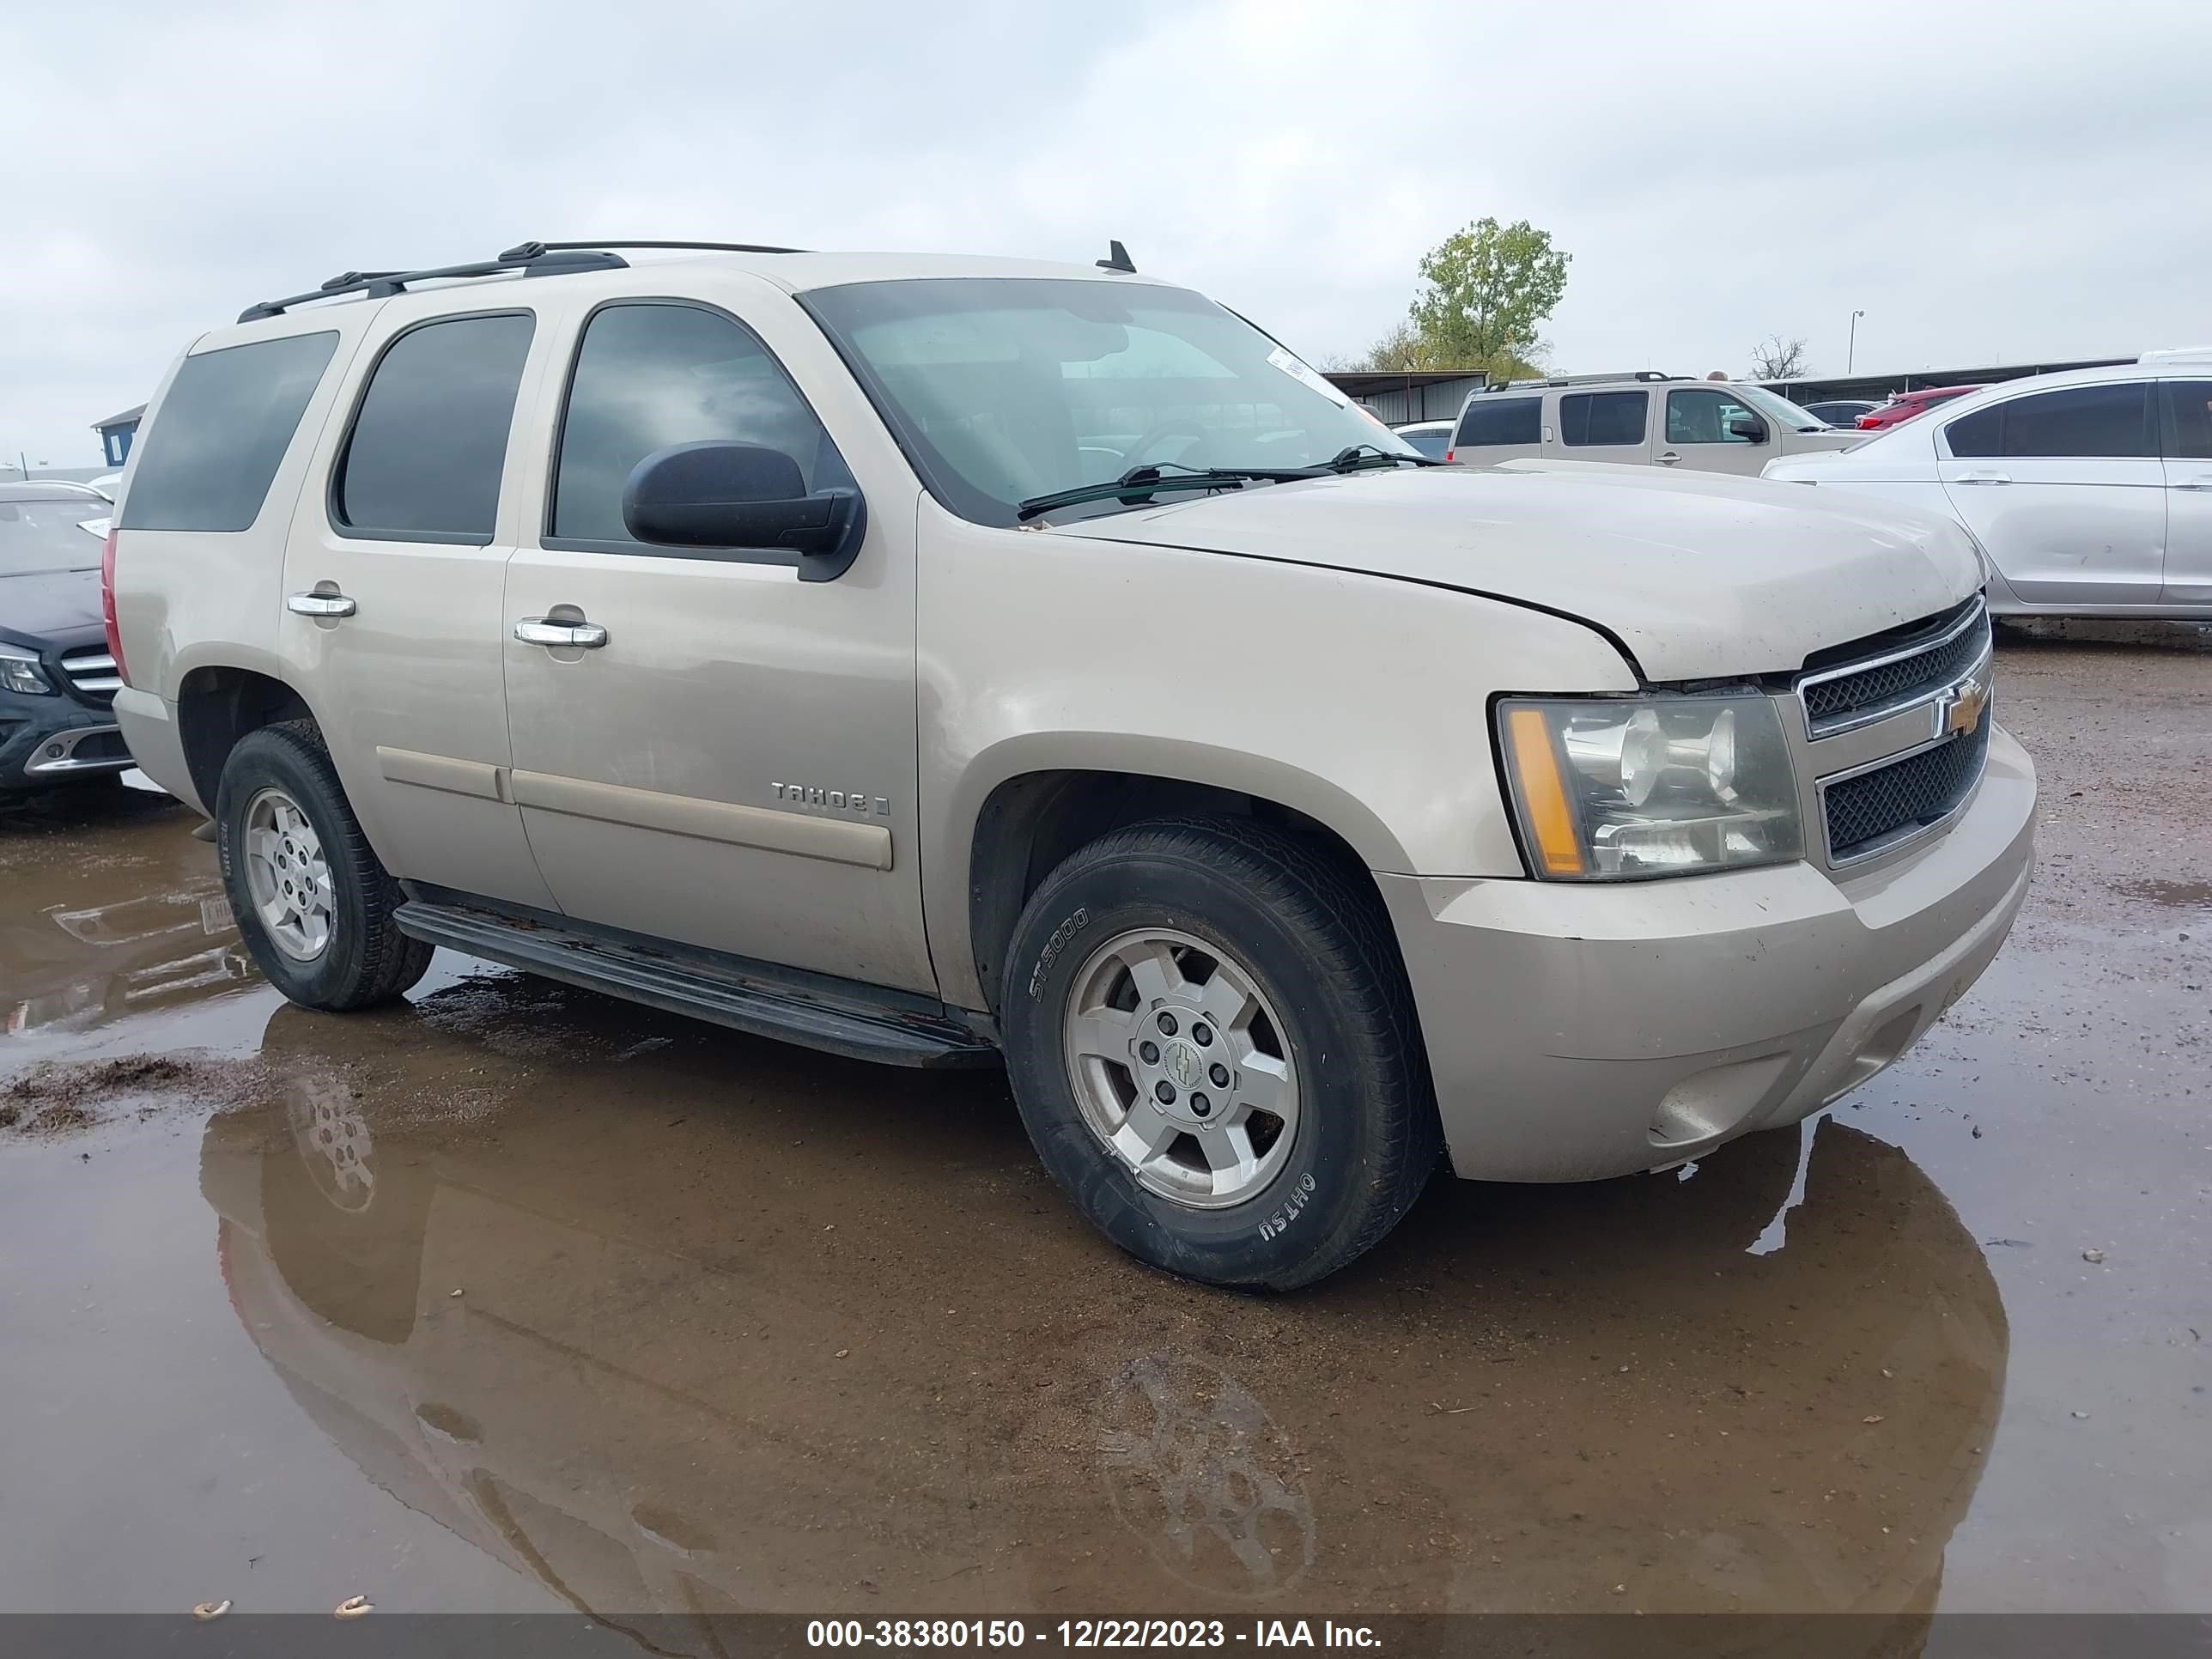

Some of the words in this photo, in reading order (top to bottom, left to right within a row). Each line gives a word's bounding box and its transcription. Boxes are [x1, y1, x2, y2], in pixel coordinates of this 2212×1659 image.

[771, 782, 866, 811] TAHOE
[1030, 908, 1089, 1003] ST5000
[1258, 1173, 1316, 1242] OHTSU
